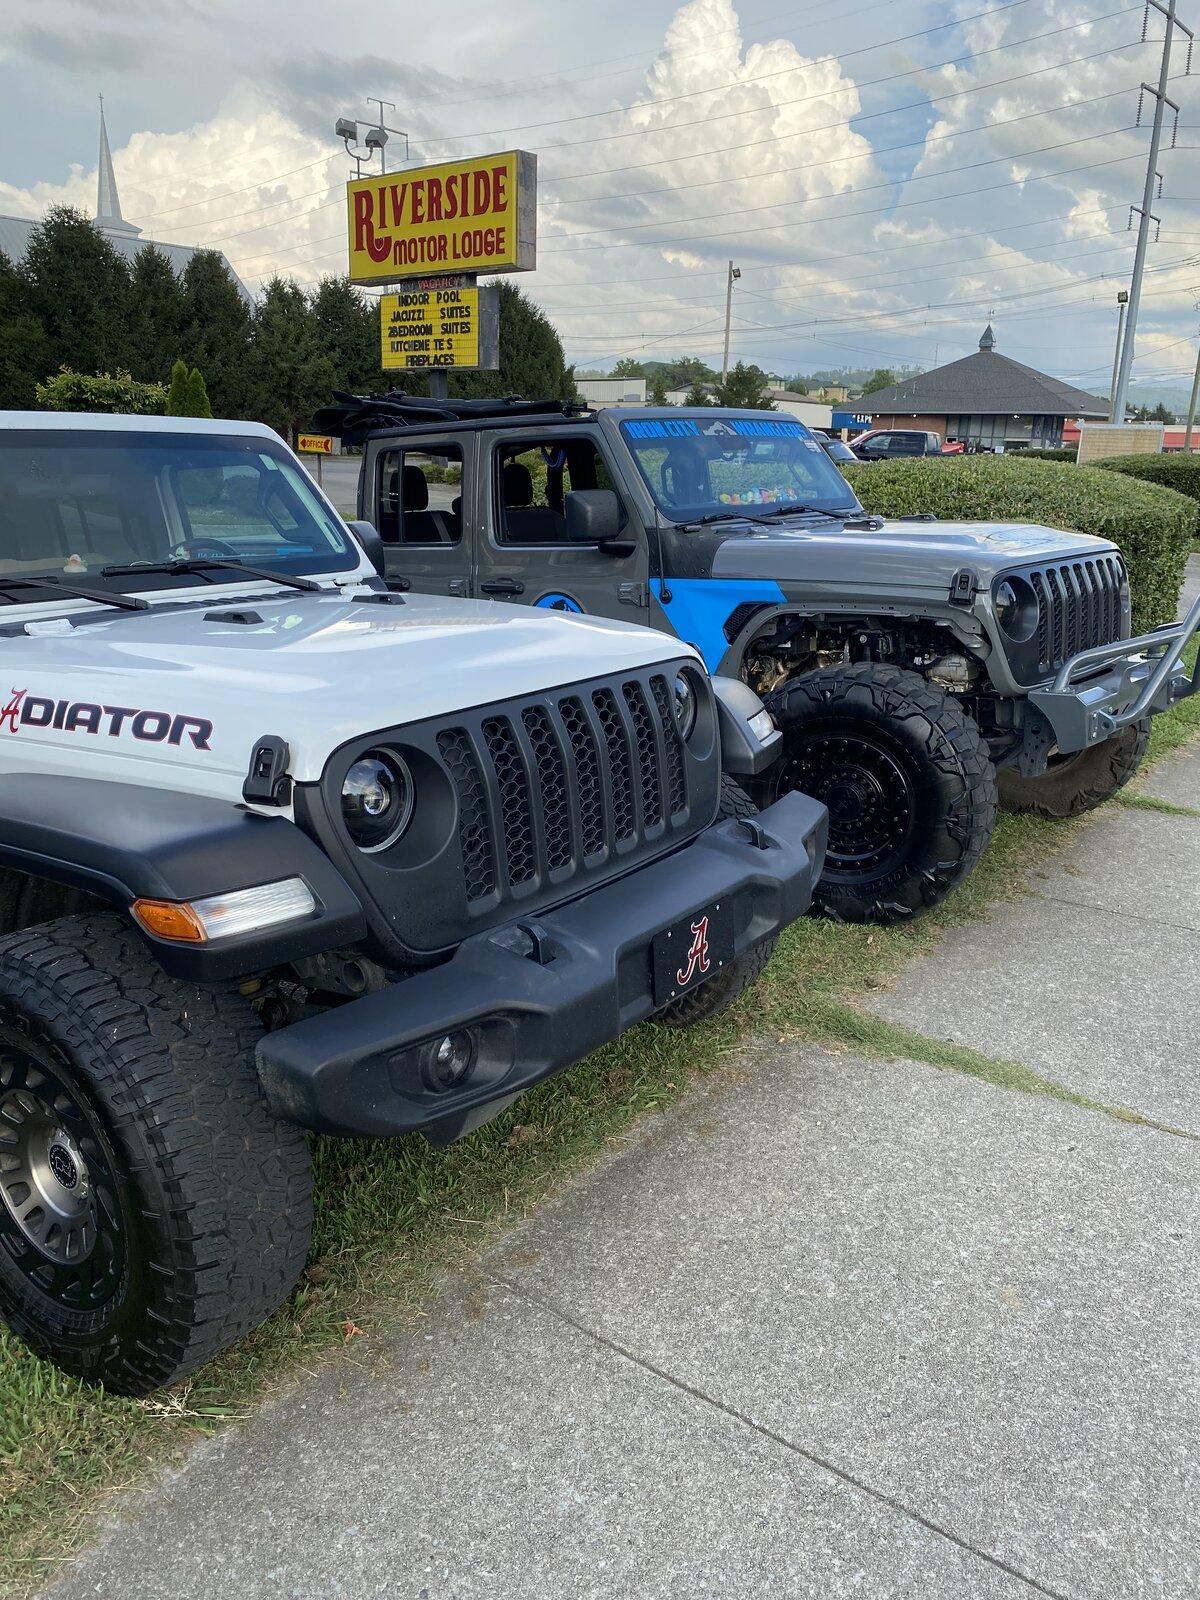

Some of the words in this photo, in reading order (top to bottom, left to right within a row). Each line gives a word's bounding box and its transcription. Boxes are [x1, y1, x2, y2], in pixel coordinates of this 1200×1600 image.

[353, 166, 508, 263] RIVERSIDE
[393, 235, 448, 265] MOTOR
[452, 227, 506, 260] LODGE
[398, 293, 430, 307] INDOOR
[436, 290, 461, 304] POOL
[391, 308, 425, 322] JACUZZI
[440, 305, 471, 319] SUITES
[388, 323, 433, 338] 2BEDROOM
[441, 321, 471, 335] SUITES
[406, 353, 455, 367] FIREPLACES
[624, 421, 669, 439] IRON
[663, 420, 700, 437] CITY
[306, 439, 324, 449] OFFICE
[677, 916, 710, 985] A
